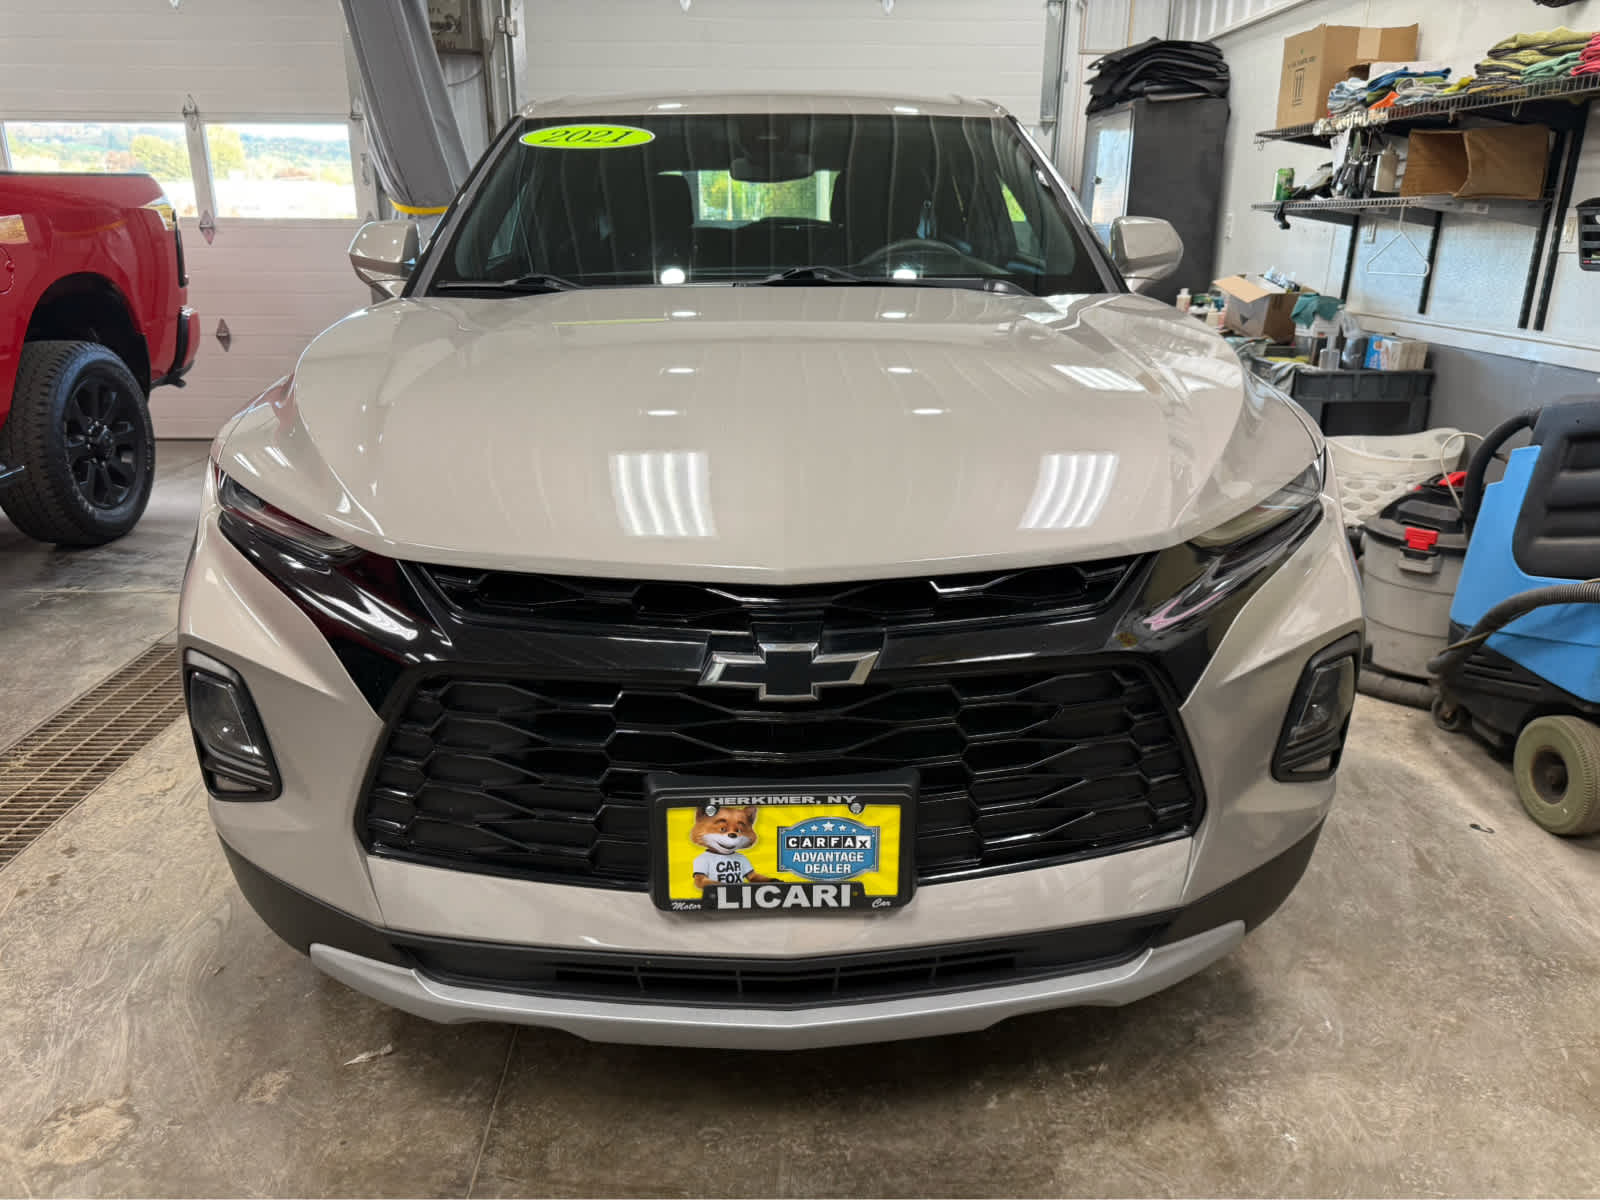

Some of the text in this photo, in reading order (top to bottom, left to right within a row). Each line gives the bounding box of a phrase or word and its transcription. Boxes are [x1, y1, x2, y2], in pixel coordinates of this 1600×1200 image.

[540, 129, 633, 143] 2021
[709, 795, 857, 805] HERKIMER, NY
[786, 836, 872, 849] CARFAX
[792, 852, 865, 863] ADVANTAGE
[716, 861, 741, 873] CAR
[804, 863, 852, 874] DEALER
[717, 872, 742, 884] FOX
[716, 885, 851, 910] LICARI
